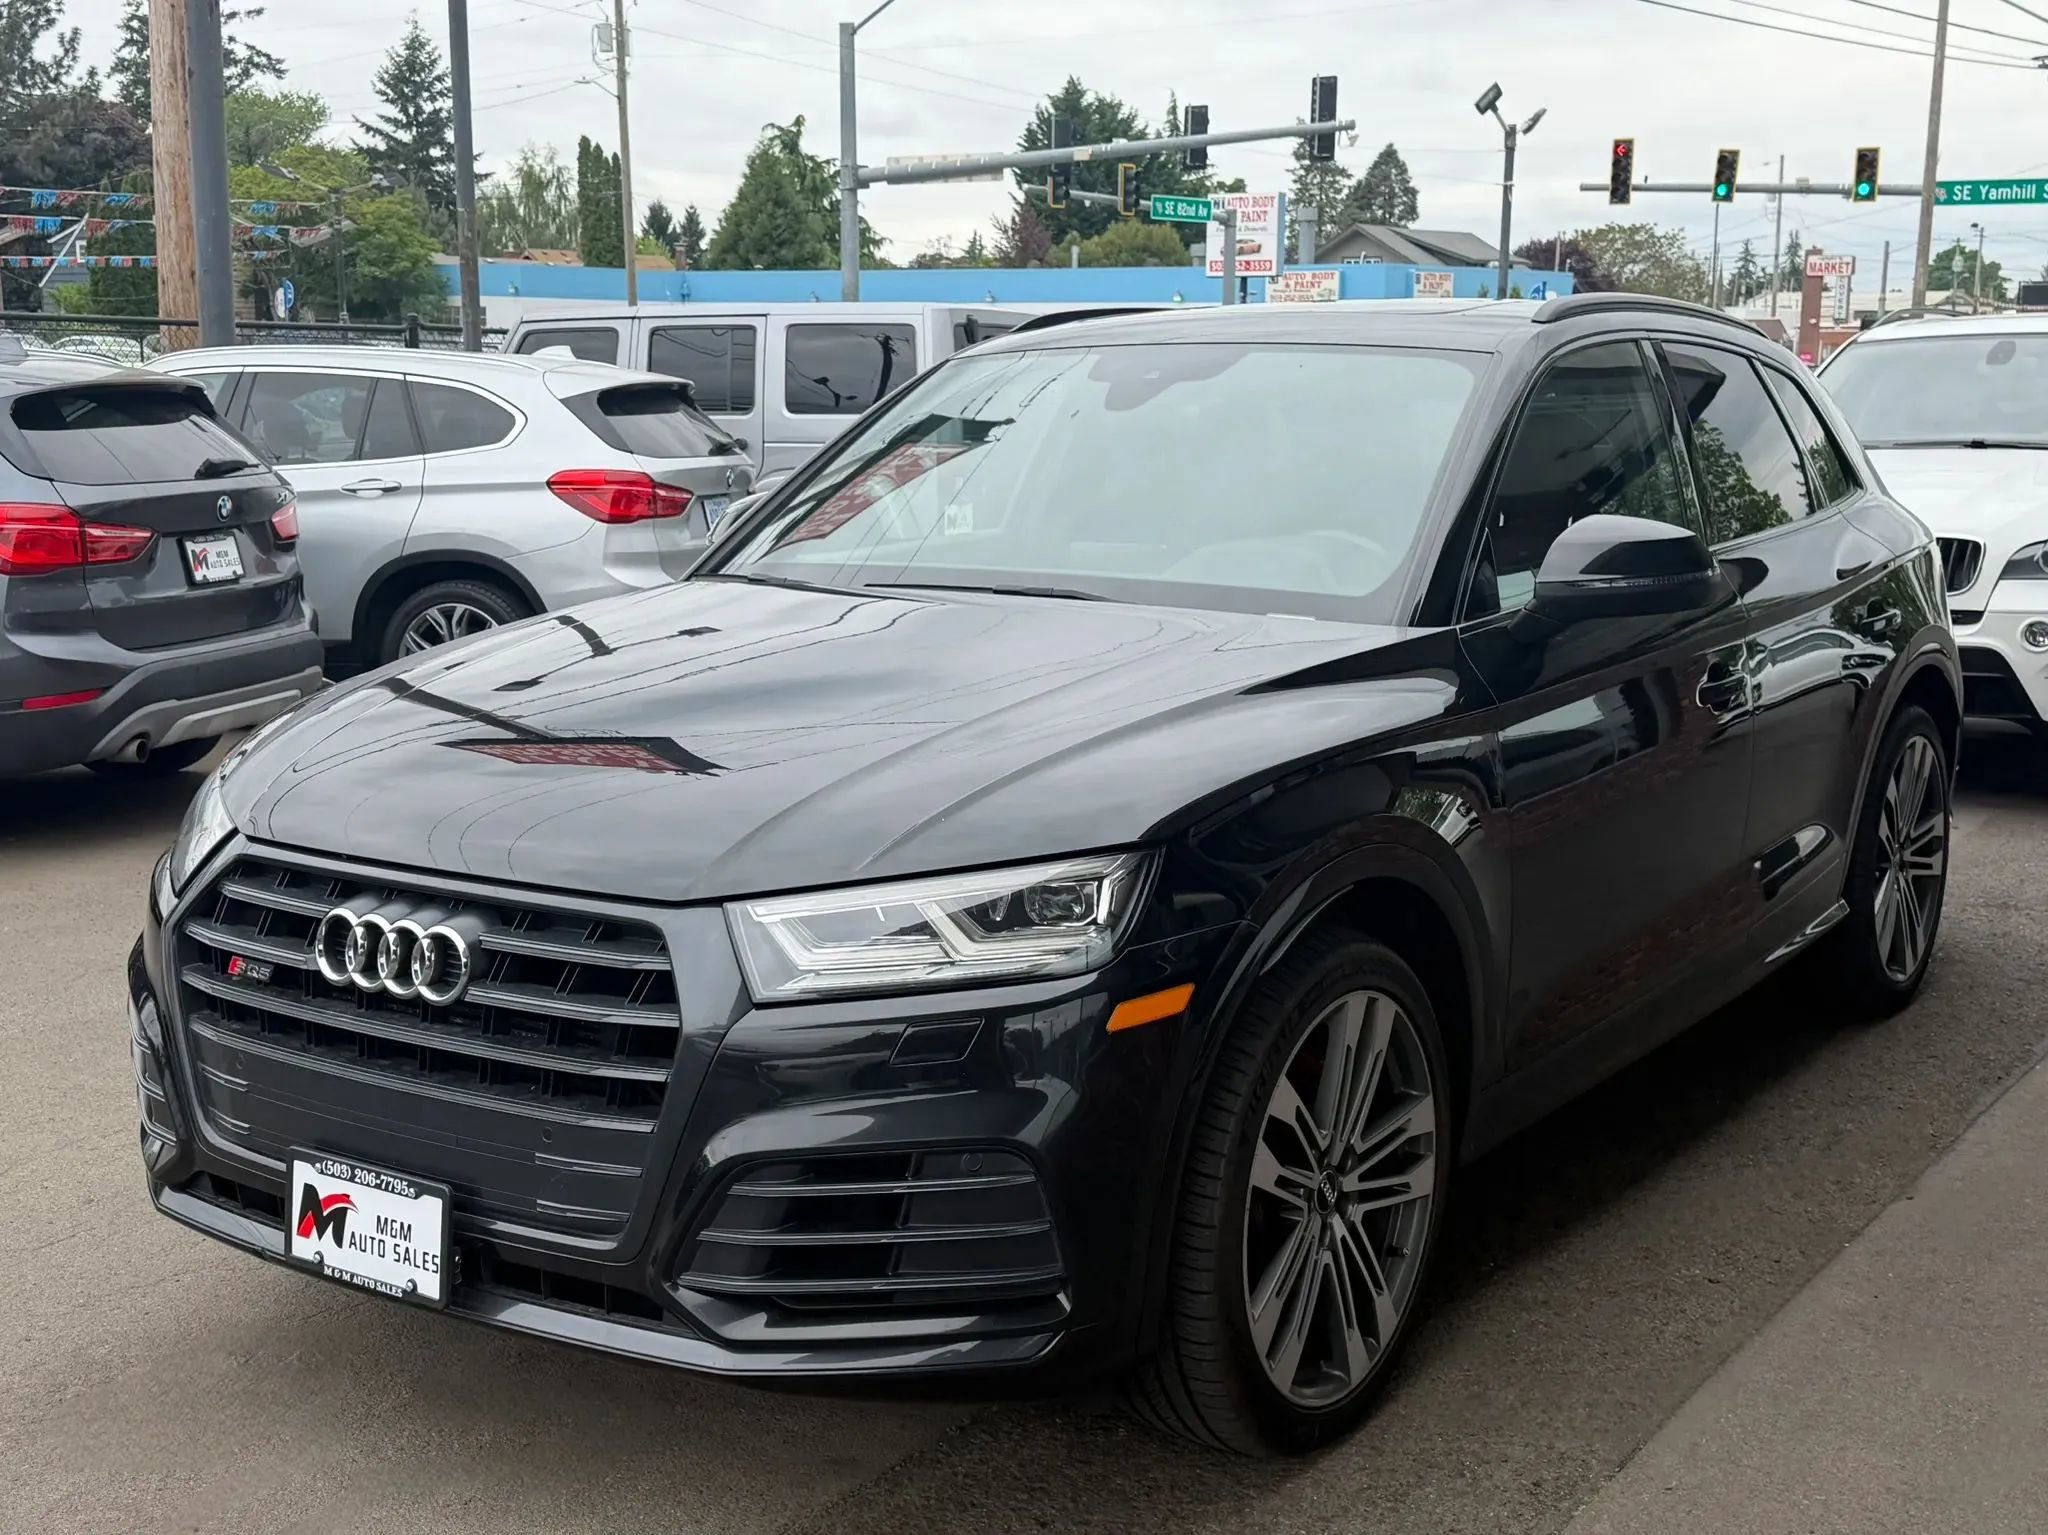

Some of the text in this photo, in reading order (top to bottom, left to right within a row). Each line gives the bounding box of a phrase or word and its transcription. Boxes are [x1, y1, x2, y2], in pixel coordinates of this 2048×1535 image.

[1953, 185, 1973, 201] SE
[1980, 184, 2036, 200] Yamhill
[1165, 201, 1175, 215] SE
[1177, 202, 1196, 217] 82nd
[1198, 204, 1209, 218] Av
[1226, 197, 1249, 208] AUTO
[1251, 196, 1276, 208] BODY
[1241, 211, 1268, 223] PAINT
[1282, 272, 1306, 281] AUTO
[1311, 272, 1336, 280] BODY
[1809, 262, 1850, 274] MARKET
[1294, 281, 1322, 289] PAINT
[223, 557, 241, 568] SALES
[230, 956, 272, 978] SQ5
[322, 1160, 409, 1195] (503) 206-7795
[376, 1215, 412, 1243] M&M
[349, 1231, 440, 1274] AUTO SALES
[323, 1266, 403, 1298] M & M AUTO SALES
